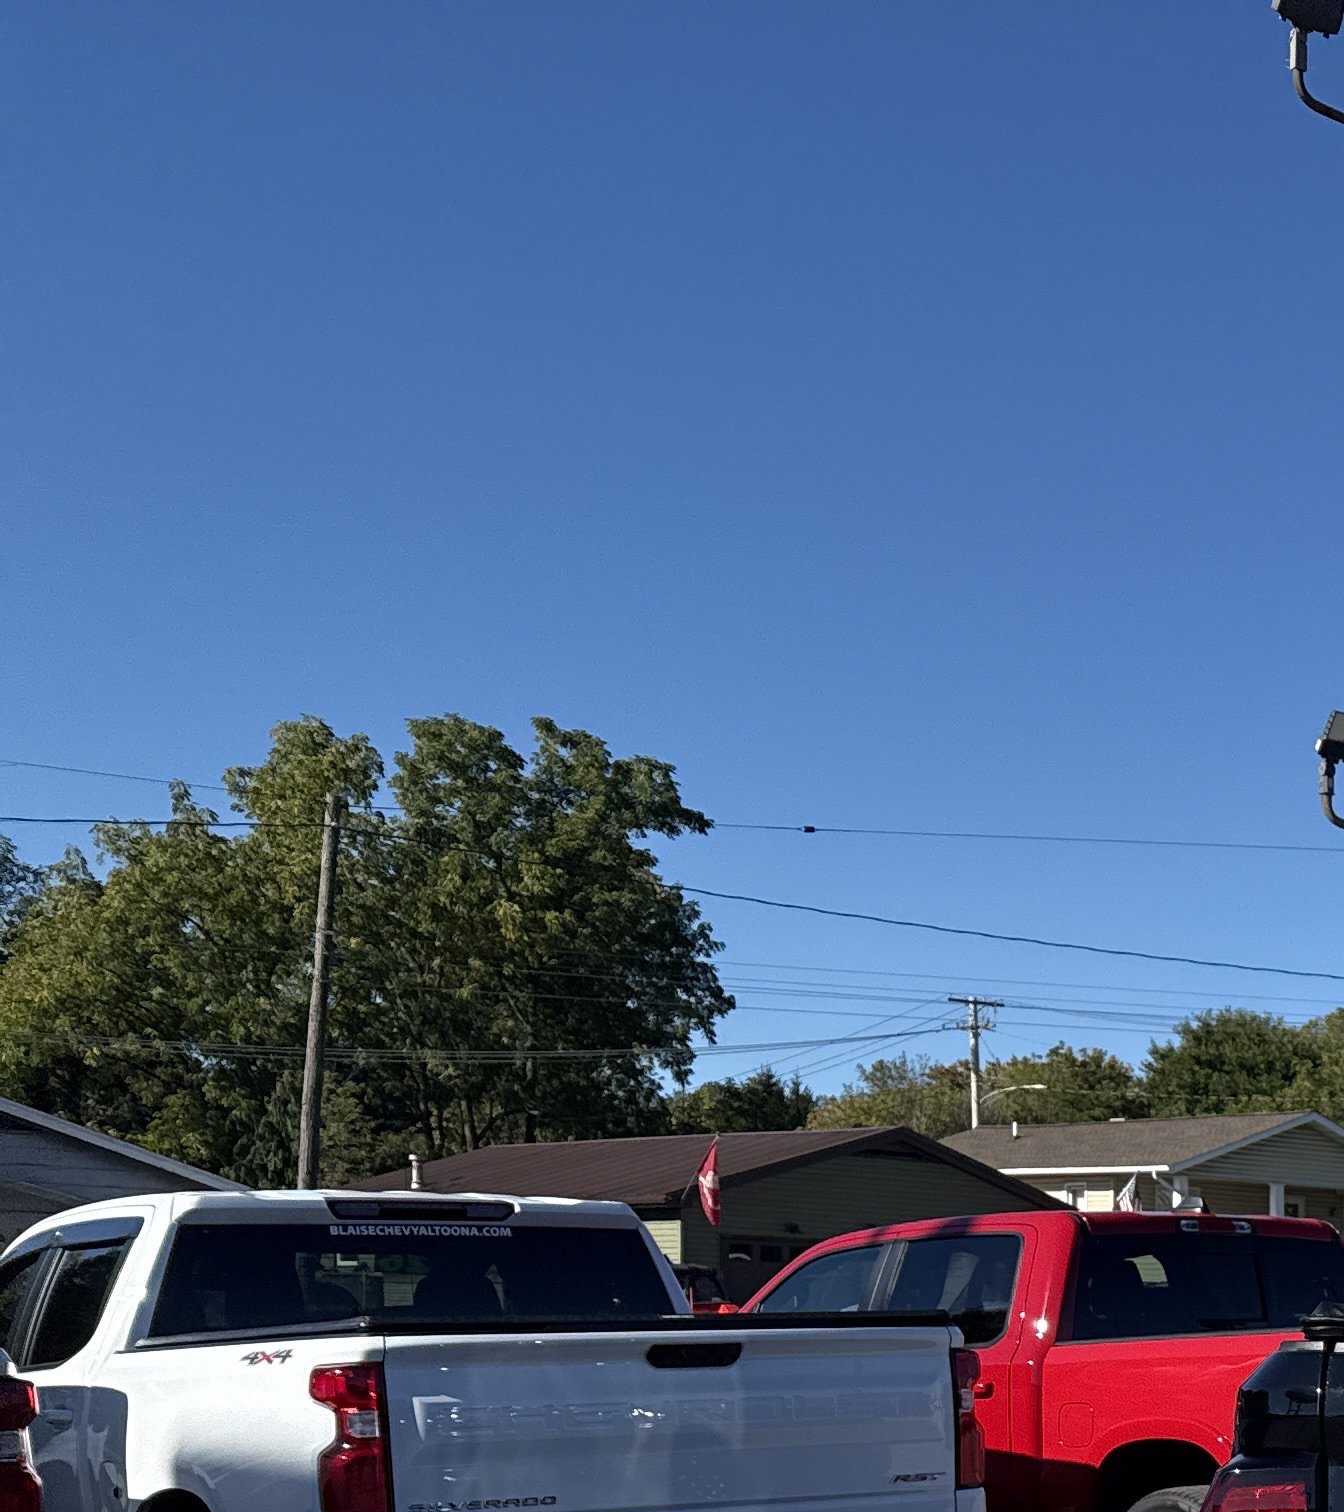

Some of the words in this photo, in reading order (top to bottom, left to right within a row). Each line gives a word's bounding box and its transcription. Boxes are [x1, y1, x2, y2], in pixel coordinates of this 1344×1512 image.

[329, 1225, 513, 1237] BLAISECHEVYALTOONA.COM
[892, 1472, 946, 1484] RST
[407, 1495, 557, 1512] SILVERADO
